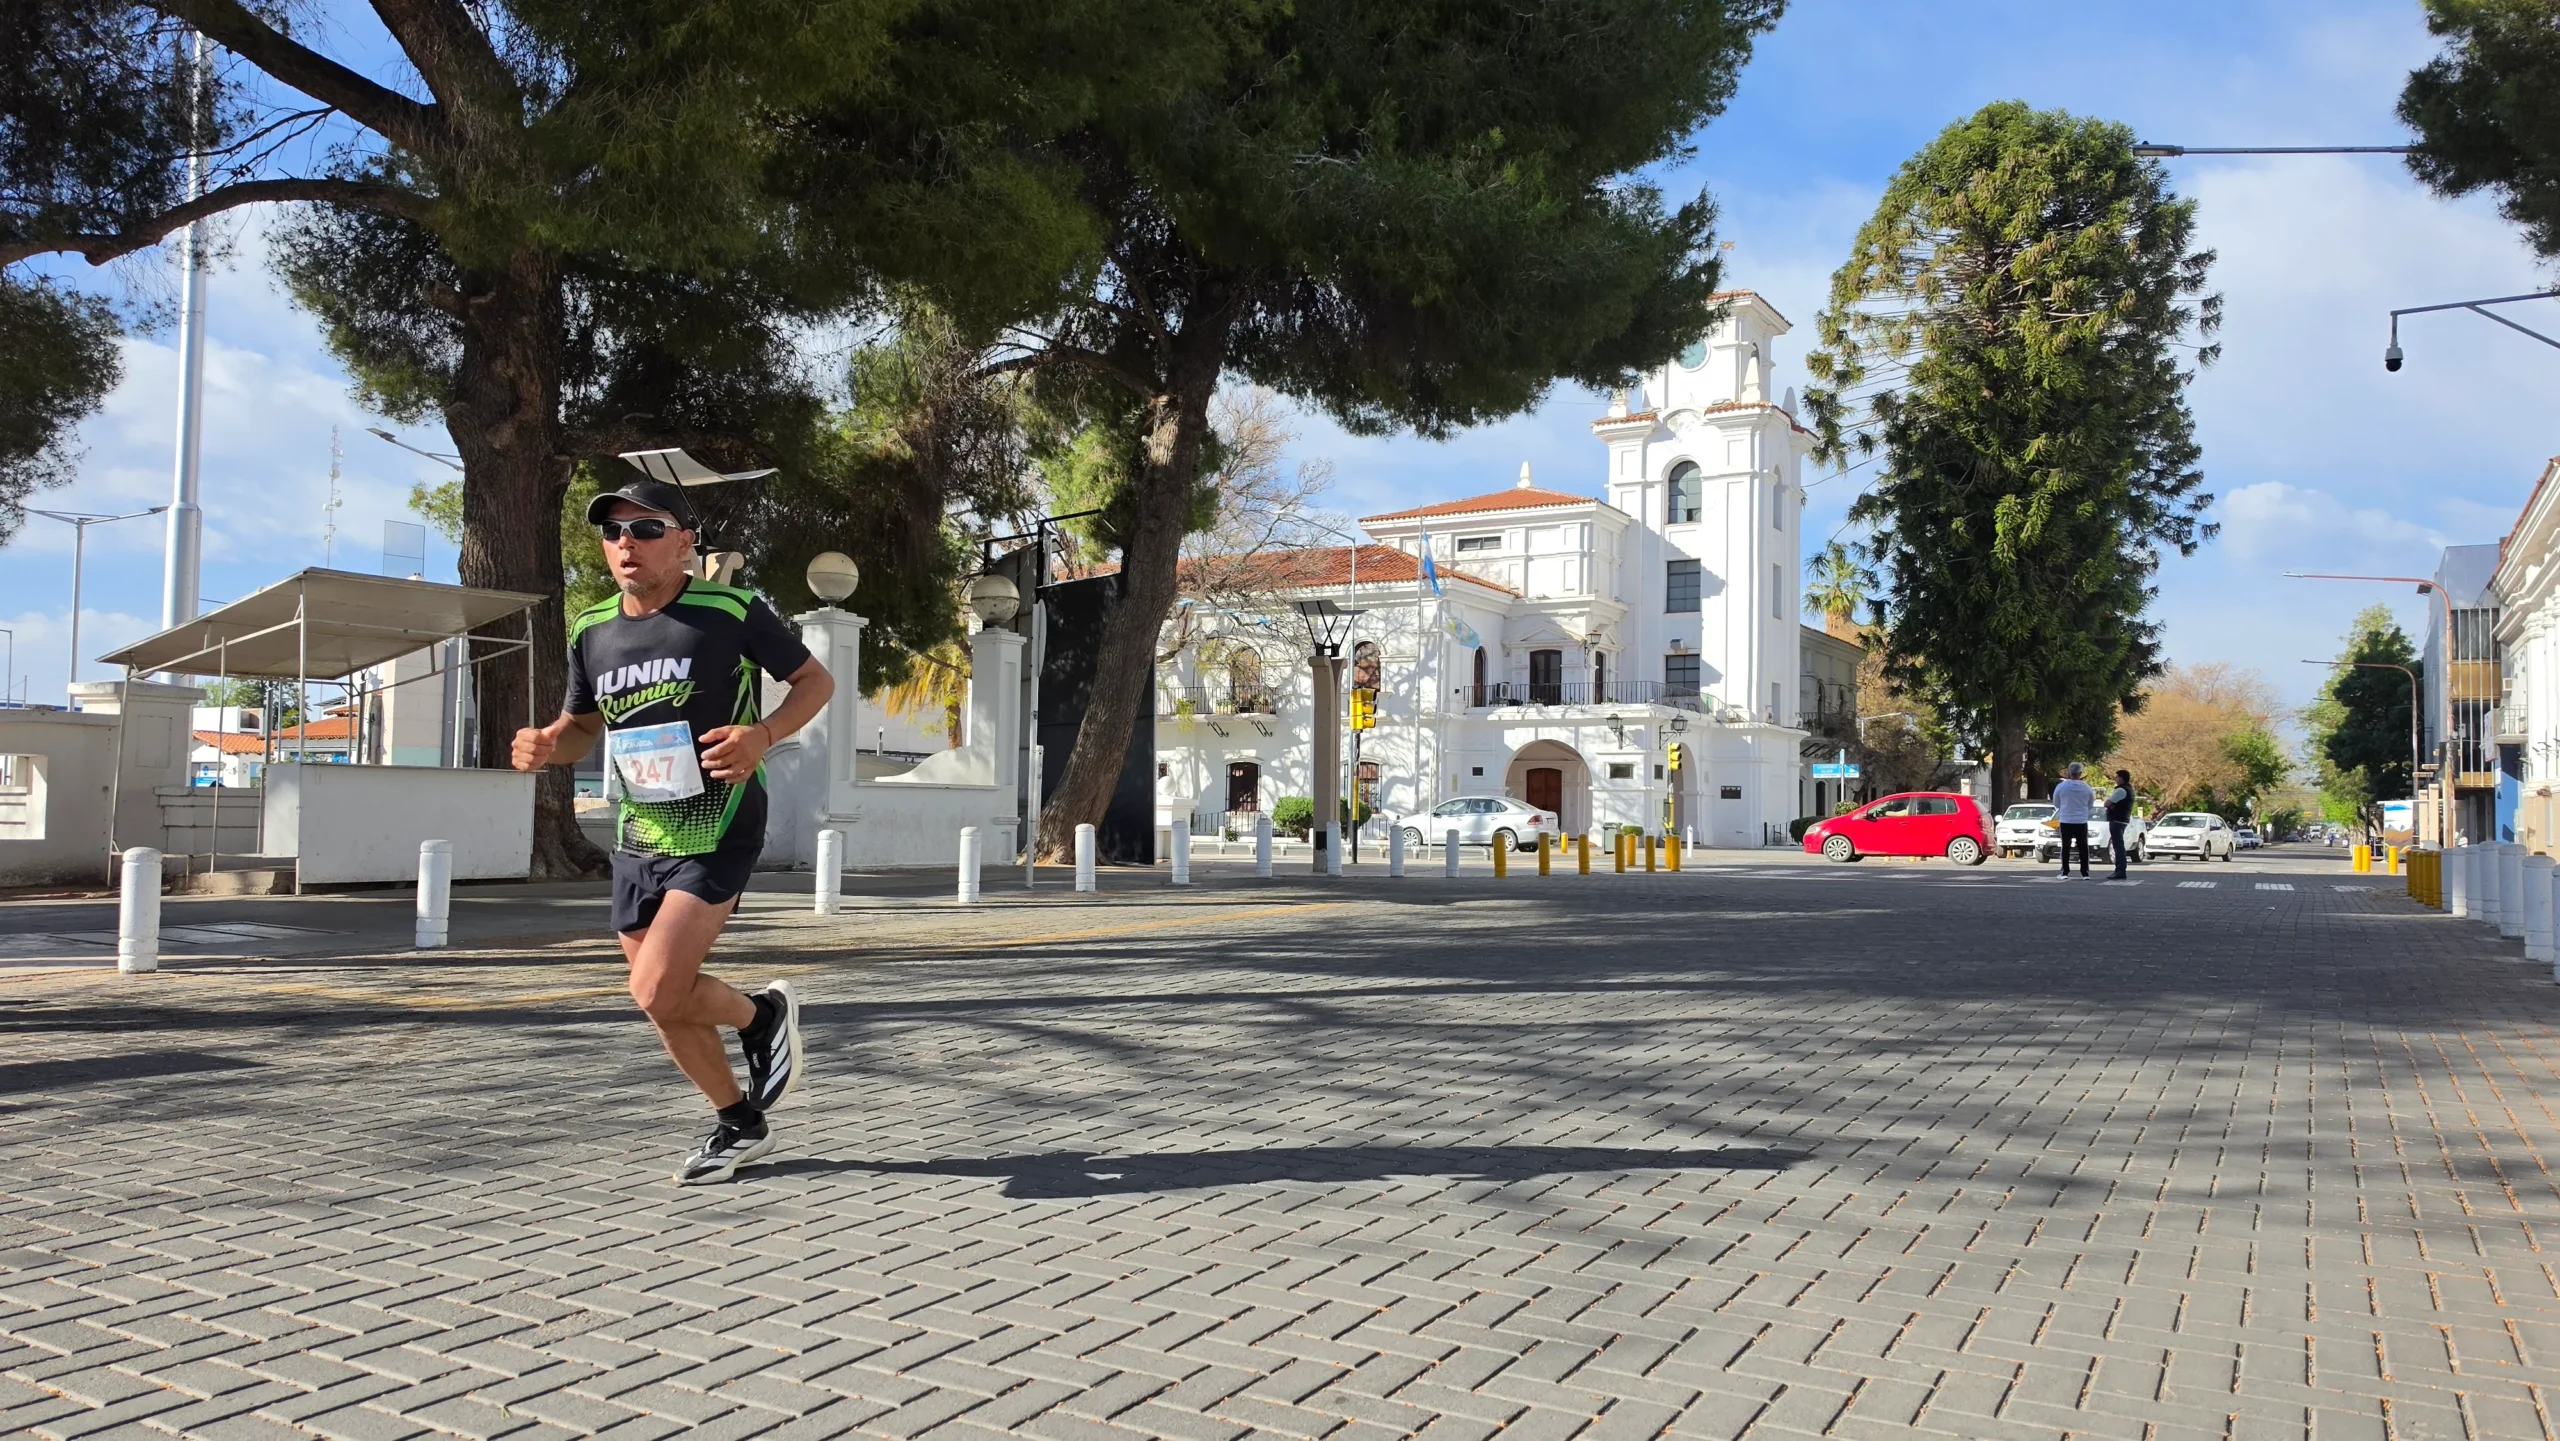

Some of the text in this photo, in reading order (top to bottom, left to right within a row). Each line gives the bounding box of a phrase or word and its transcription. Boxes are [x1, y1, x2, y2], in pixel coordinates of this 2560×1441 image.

[595, 658, 692, 702] JUNIN
[598, 679, 697, 724] Running
[630, 756, 675, 784] 247
